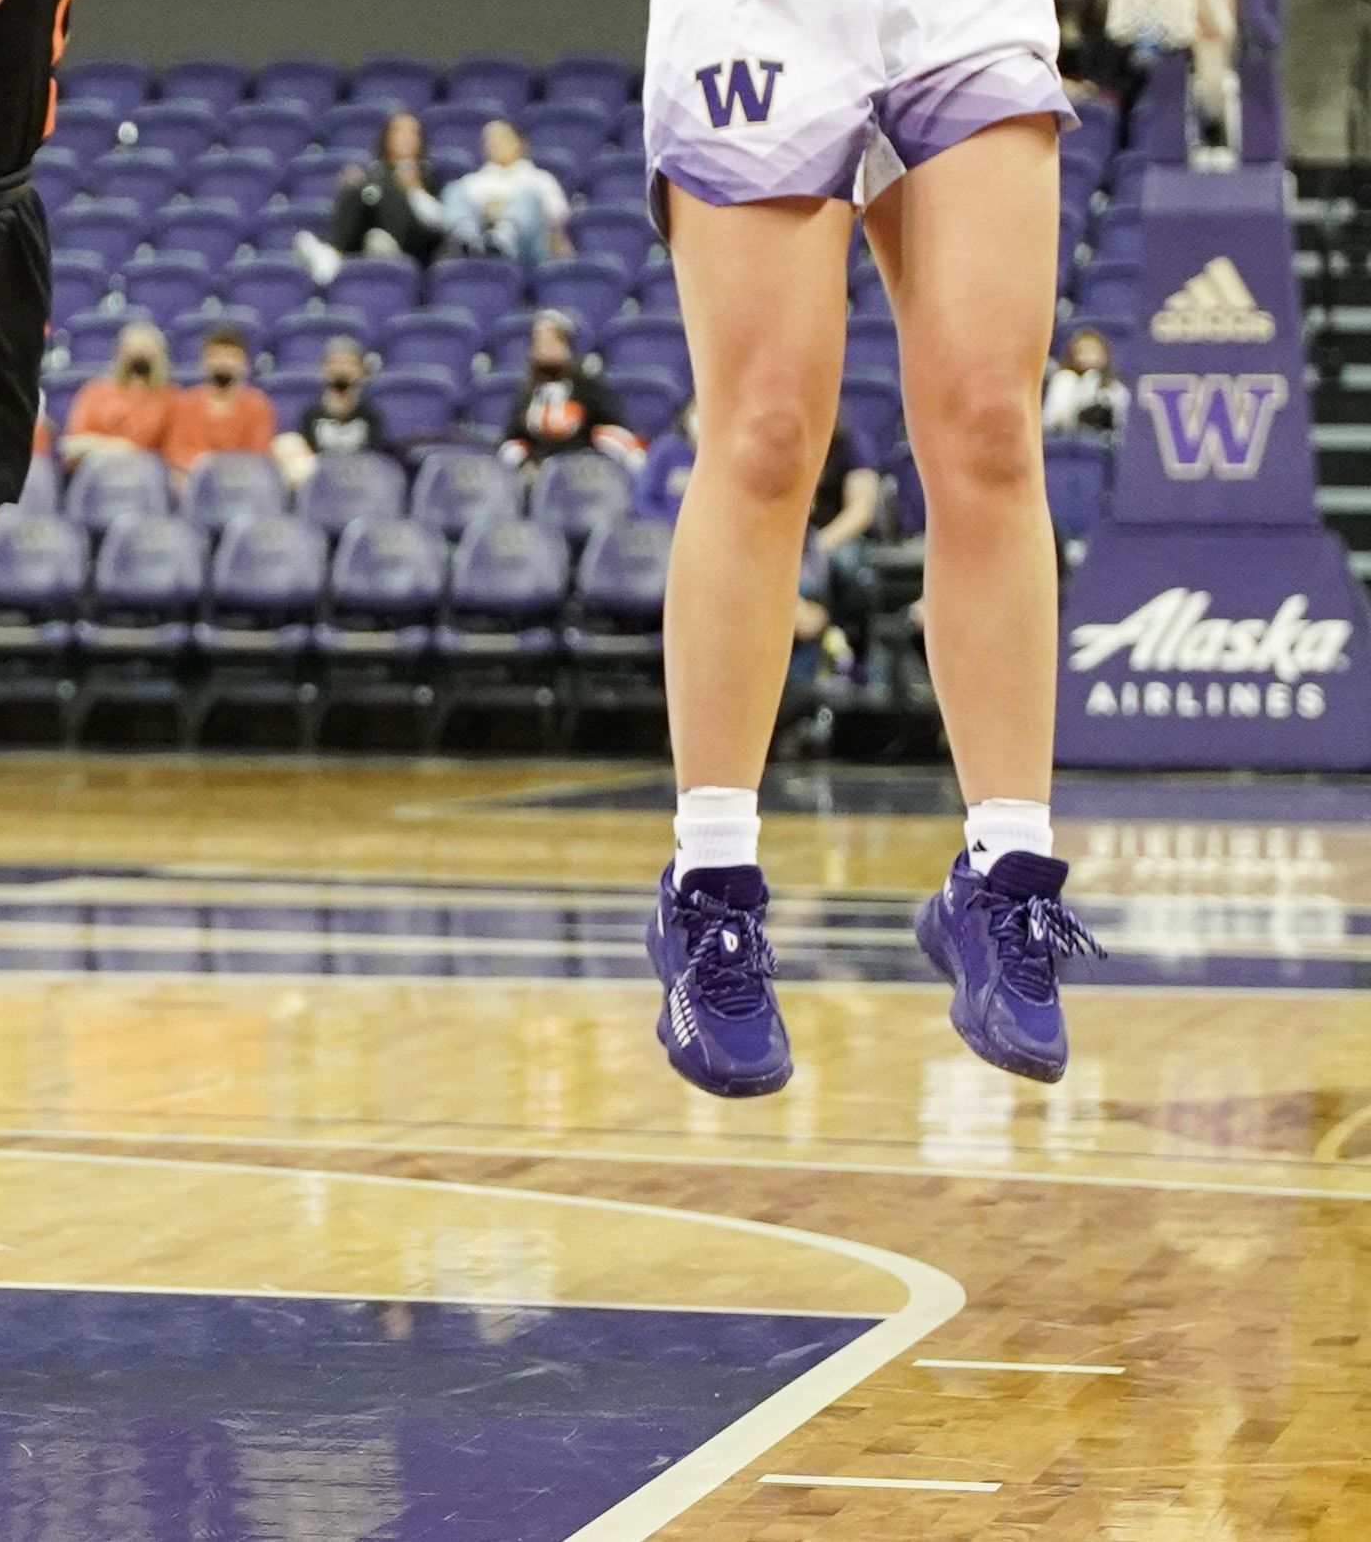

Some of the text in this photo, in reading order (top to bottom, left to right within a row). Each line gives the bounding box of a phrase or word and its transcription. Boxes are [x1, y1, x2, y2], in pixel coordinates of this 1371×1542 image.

[694, 57, 784, 131] W
[1137, 372, 1290, 481] W
[1067, 586, 1355, 682] Alaska
[1085, 681, 1326, 719] AIRLINES
